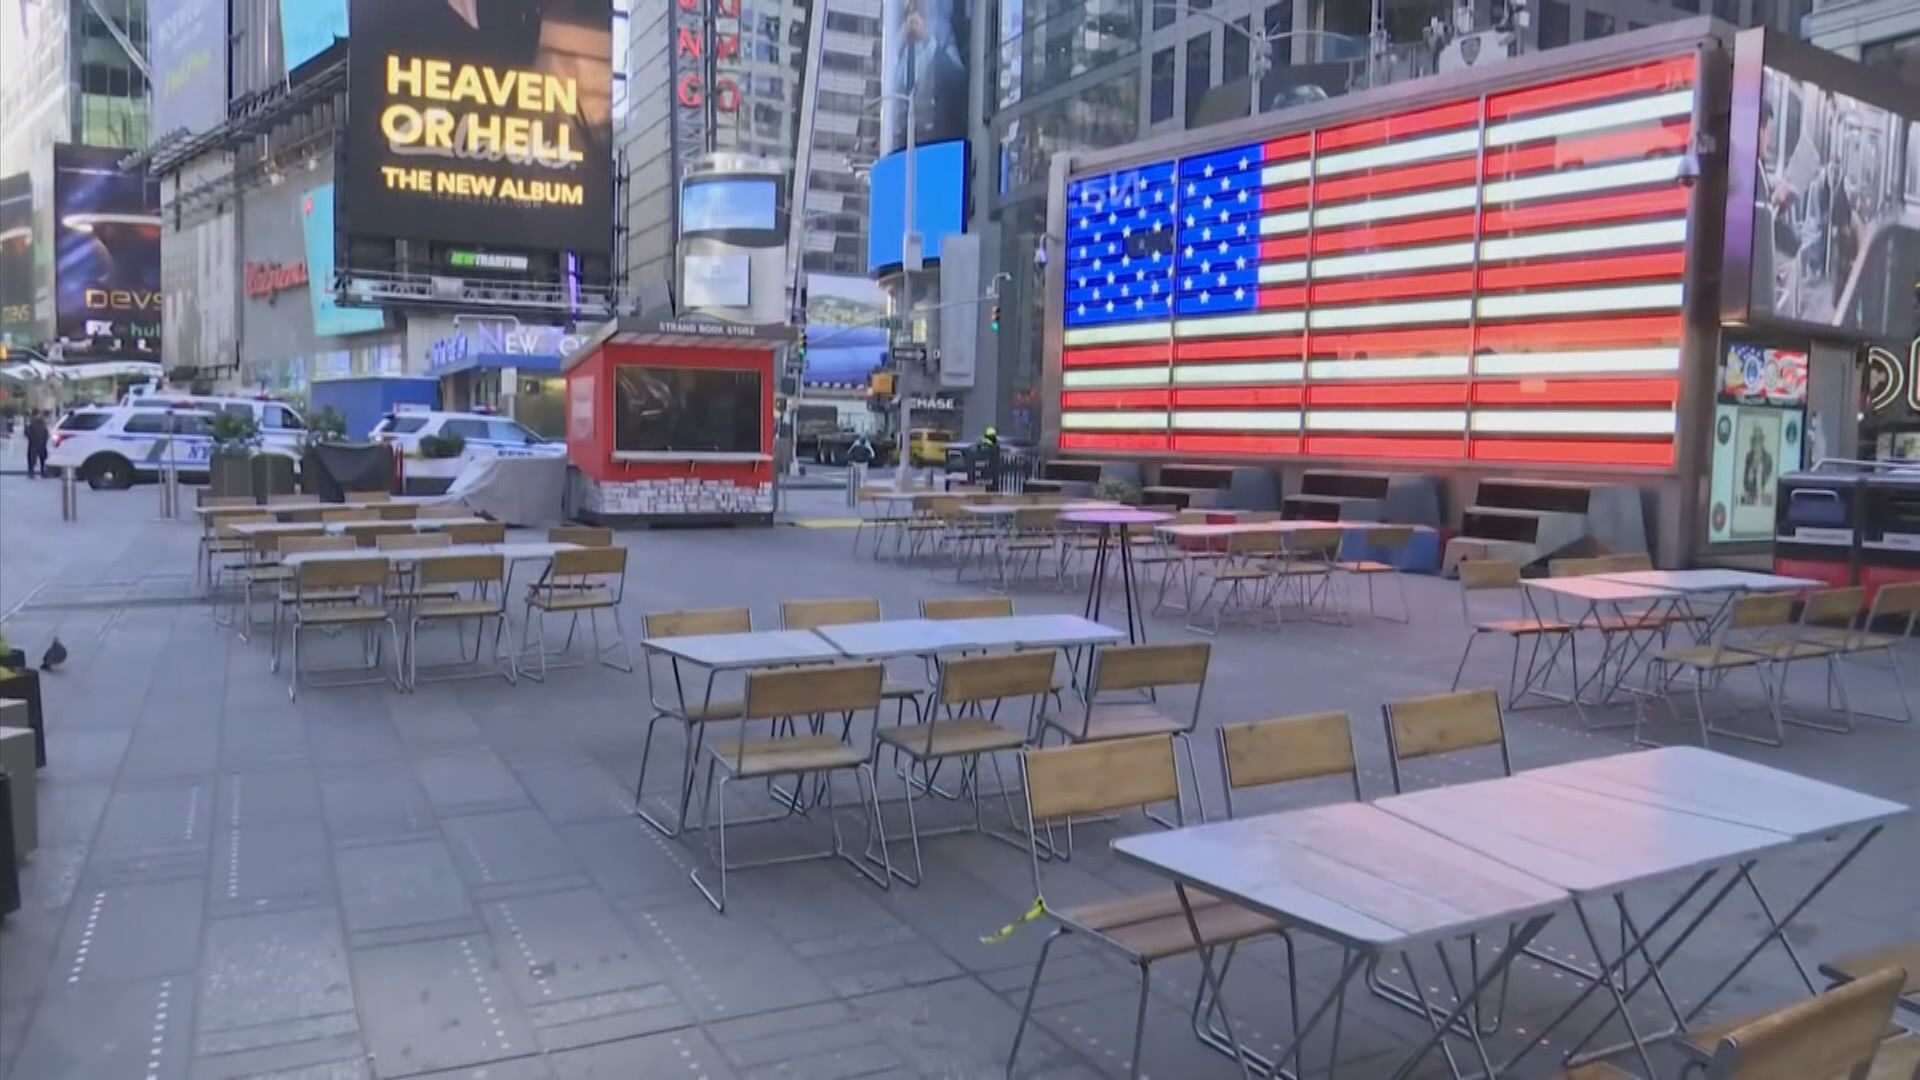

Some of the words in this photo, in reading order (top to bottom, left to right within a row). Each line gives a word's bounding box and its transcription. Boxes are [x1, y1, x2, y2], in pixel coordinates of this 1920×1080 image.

[387, 55, 577, 115] HEAVEN
[381, 103, 455, 149] OR
[467, 112, 584, 162] HELL
[381, 165, 433, 192] THE
[436, 171, 496, 197] NEW
[499, 177, 584, 206] ALBUM
[86, 320, 113, 336] FX
[478, 320, 539, 356] NEW
